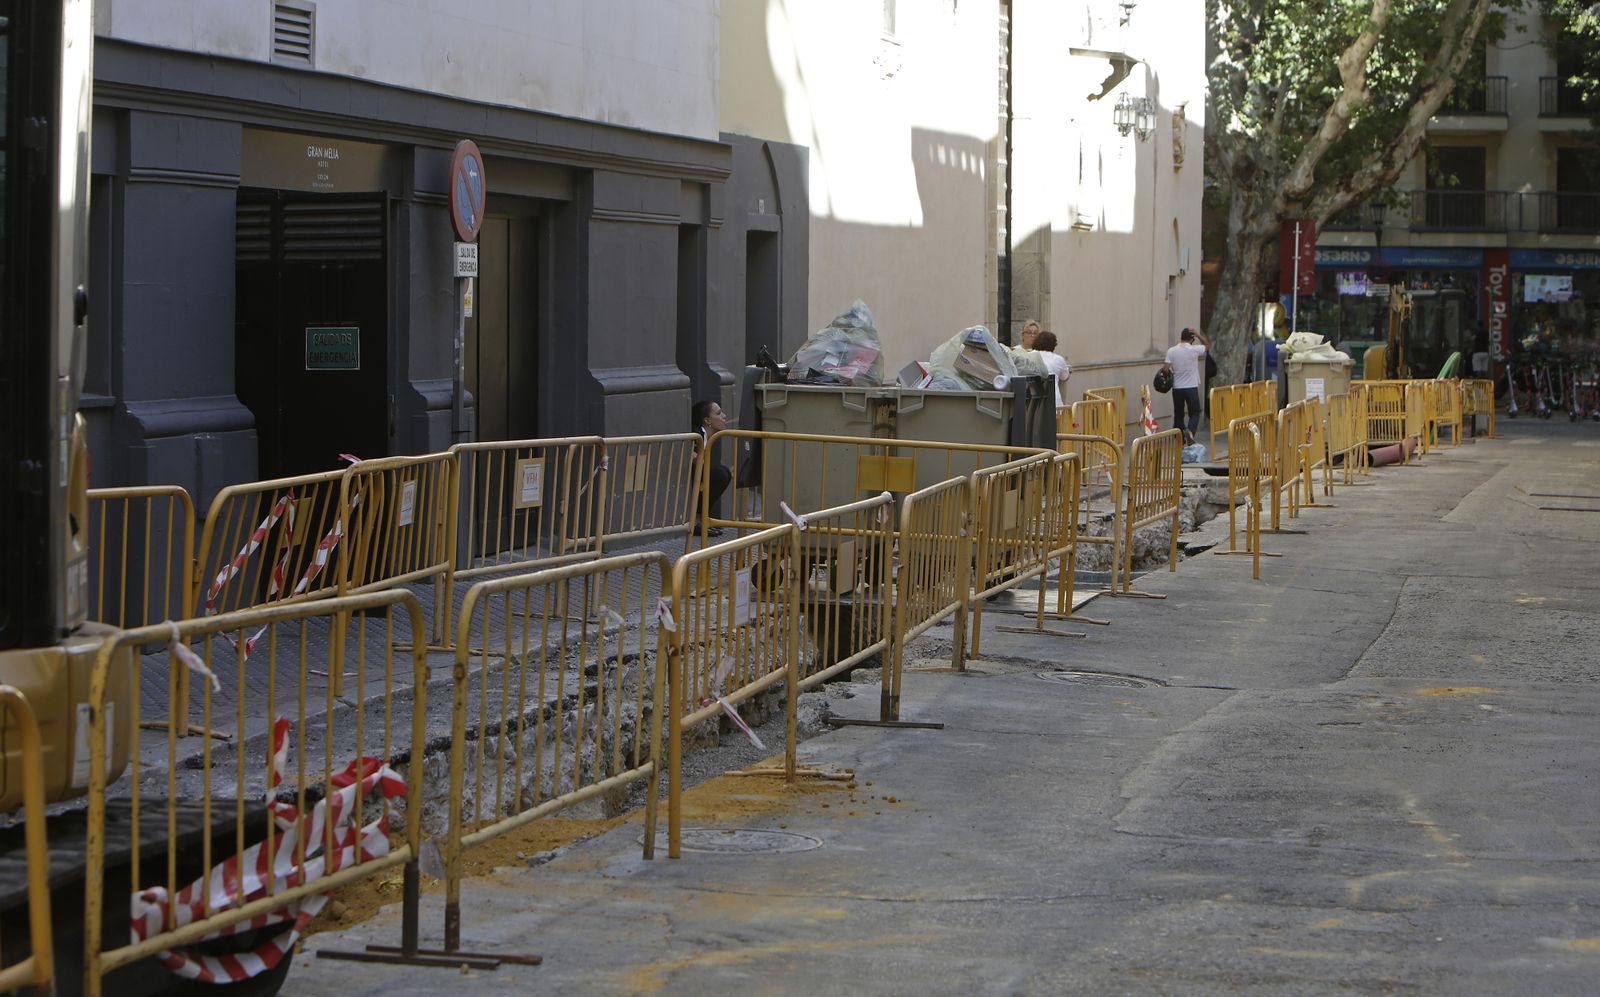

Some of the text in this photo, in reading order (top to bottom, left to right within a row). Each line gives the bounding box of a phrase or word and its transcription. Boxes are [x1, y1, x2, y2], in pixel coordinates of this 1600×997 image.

[307, 146, 323, 157] GRAN
[1488, 264, 1506, 296] Toy
[309, 352, 357, 365] EMERGENCIA
